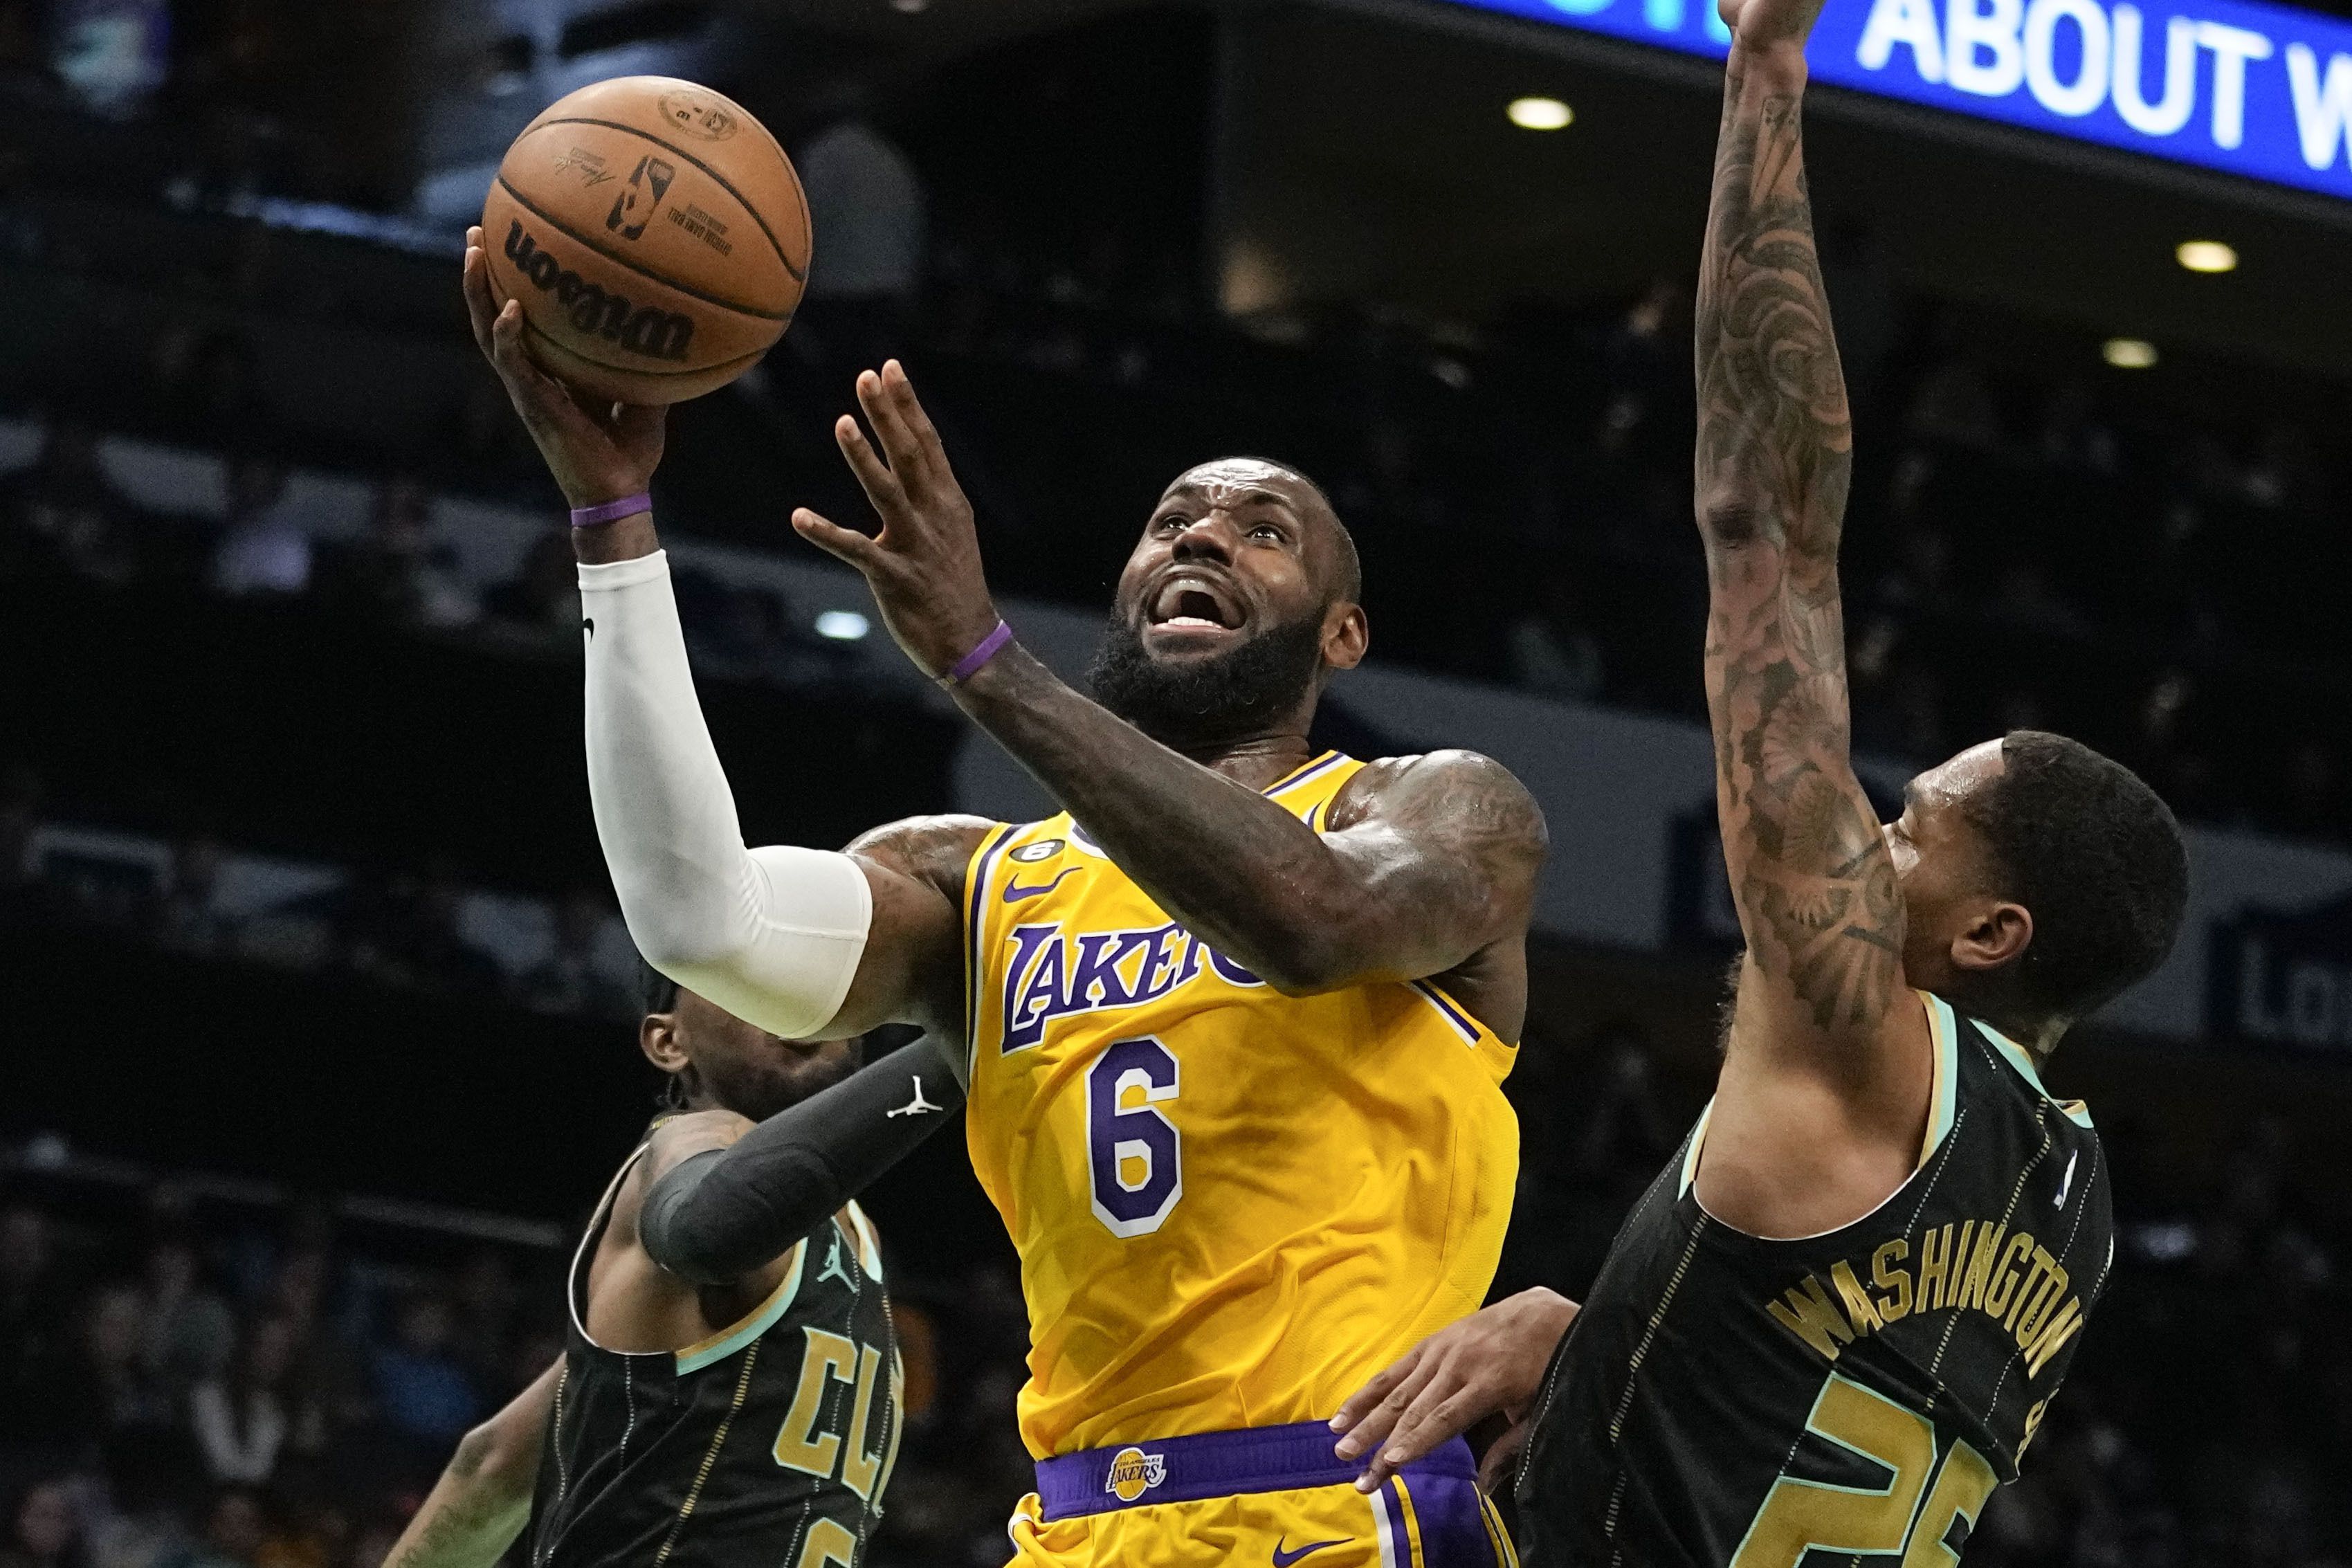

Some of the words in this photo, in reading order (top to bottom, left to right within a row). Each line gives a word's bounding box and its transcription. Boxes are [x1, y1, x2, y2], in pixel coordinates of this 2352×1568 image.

[1856, 0, 2274, 150] ABOUT
[1021, 841, 1056, 861] 6
[1001, 920, 1268, 1057] LAKE
[1084, 1034, 1183, 1239] 6
[1765, 1218, 2084, 1381] WASHINGTON
[1106, 1463, 1164, 1490] LAKERS
